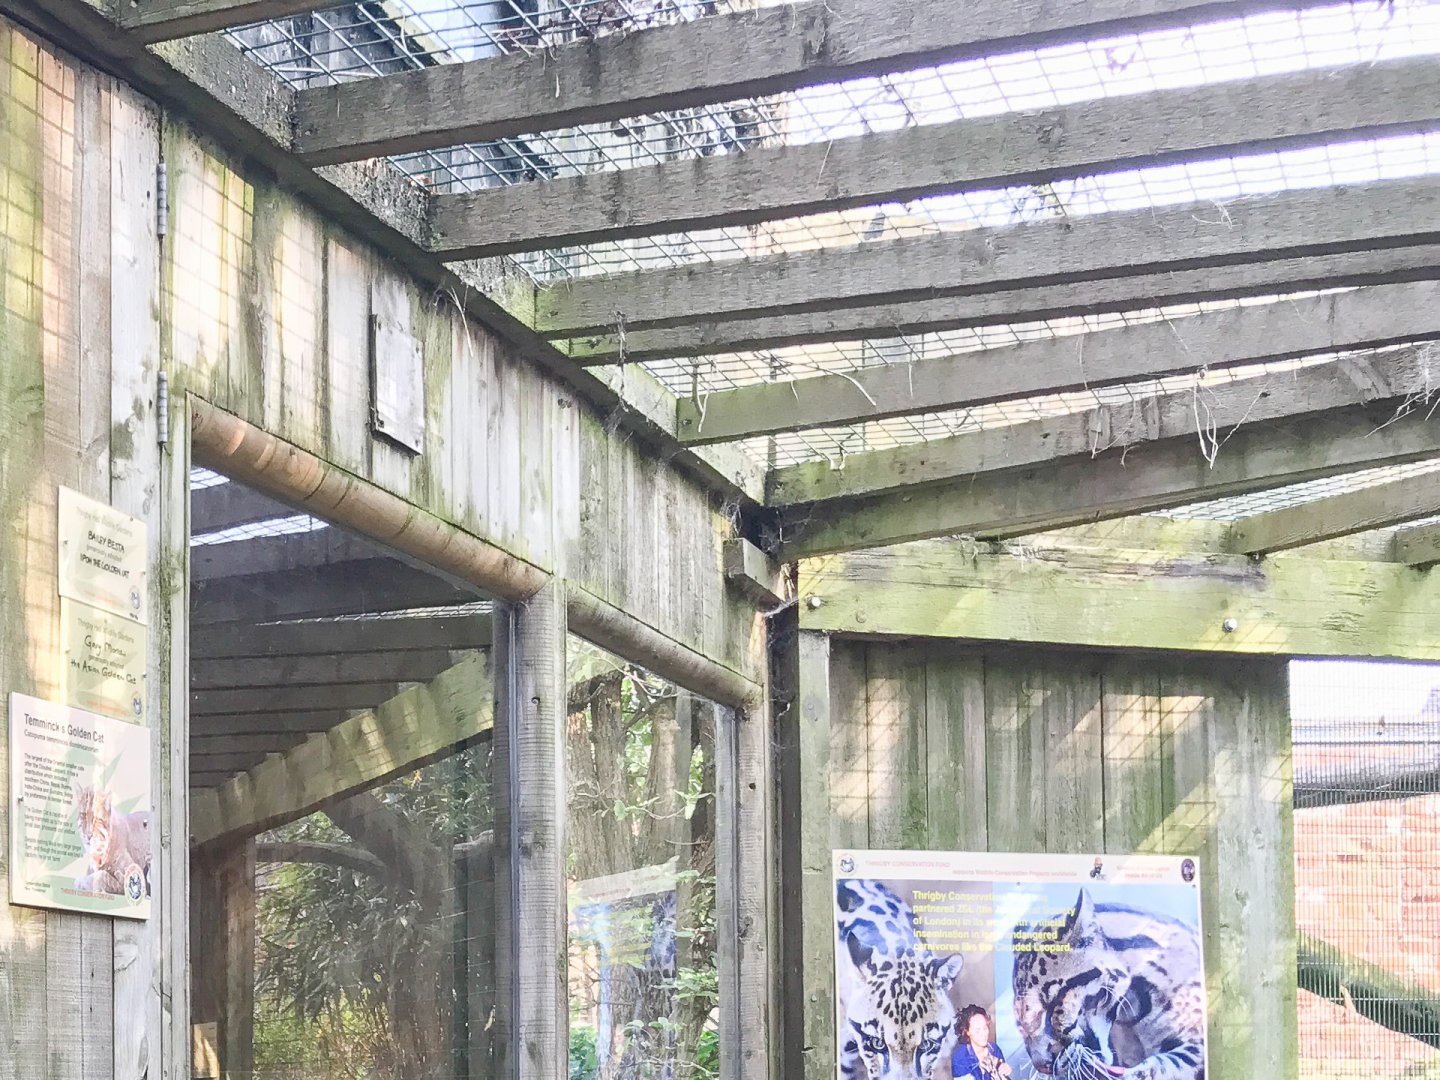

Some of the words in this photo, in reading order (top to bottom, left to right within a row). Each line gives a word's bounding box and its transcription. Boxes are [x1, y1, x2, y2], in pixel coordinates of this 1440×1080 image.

[24, 713, 66, 734] Temmincks
[67, 723, 92, 741] Golden
[93, 731, 105, 744] Cat
[912, 890, 947, 903] Thrigby
[948, 892, 1003, 902] Conservati
[912, 904, 955, 915] partnered
[912, 917, 922, 925] of
[1005, 931, 1058, 942] ndangered
[1033, 943, 1073, 954] Leopard.
